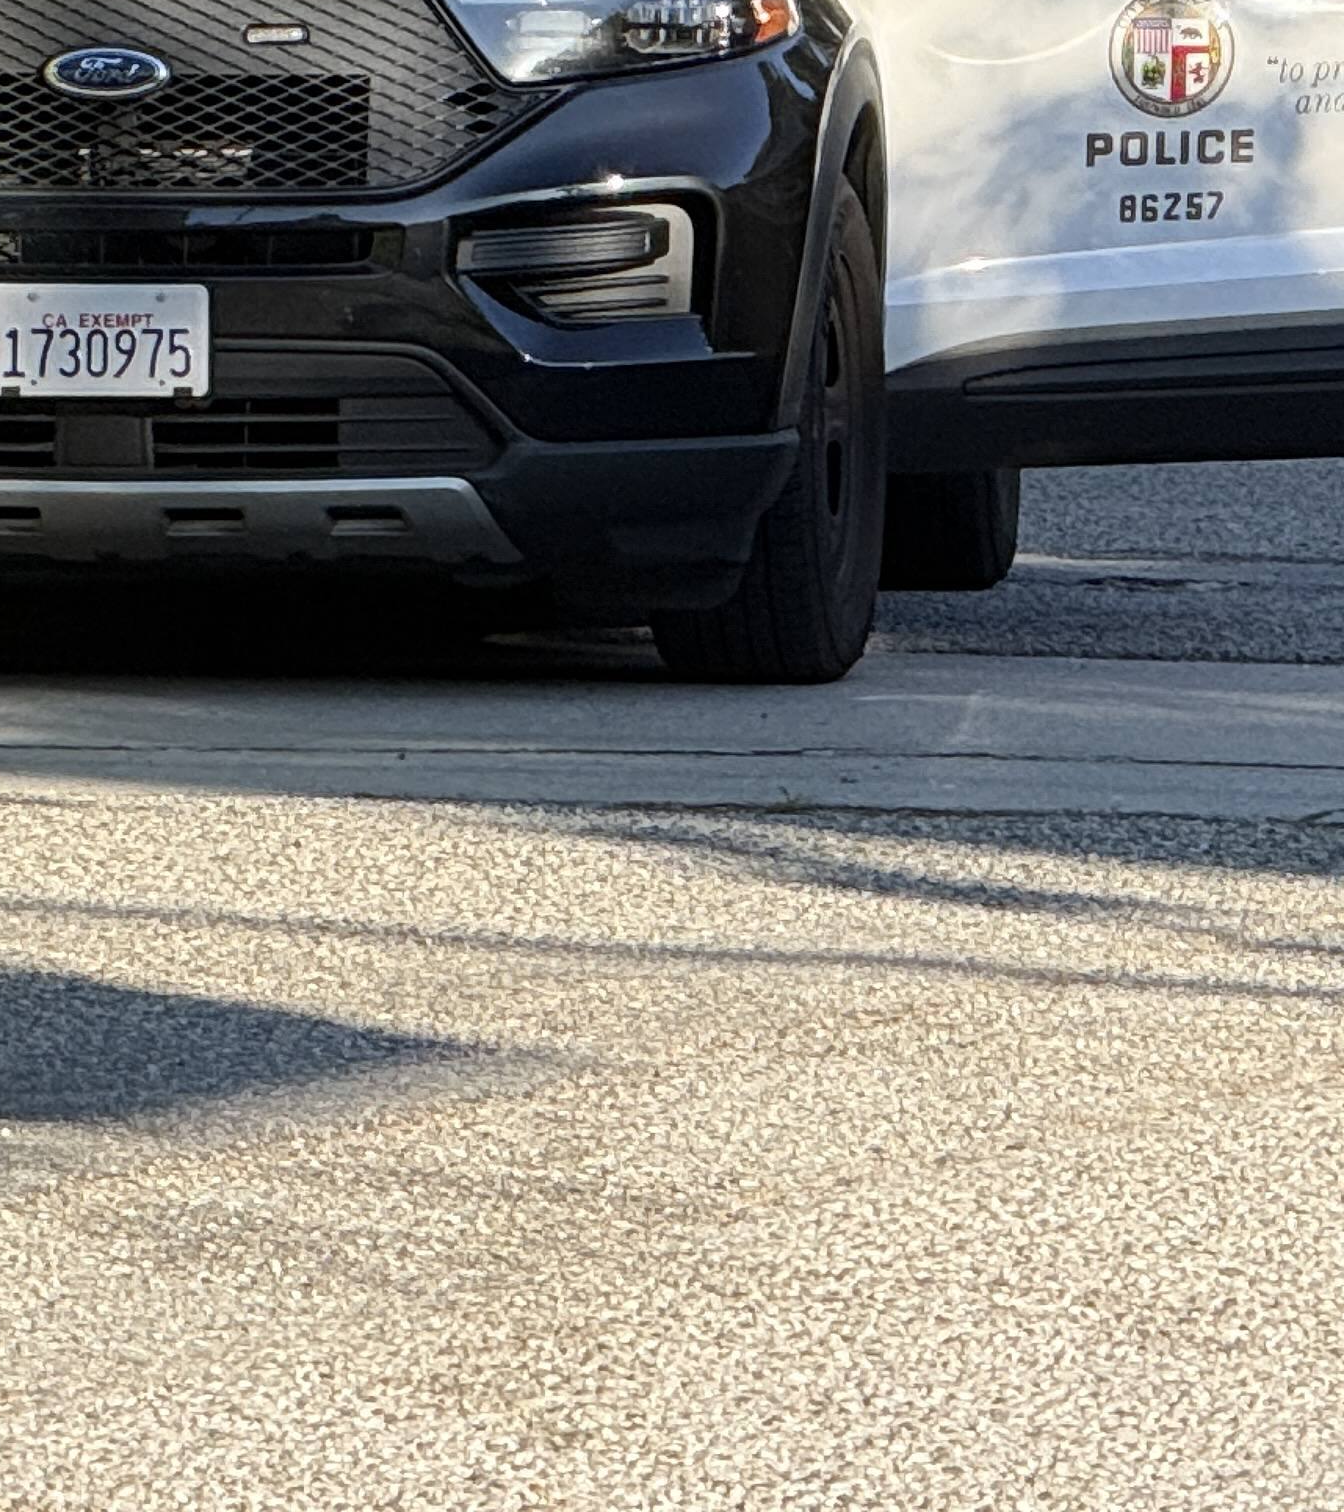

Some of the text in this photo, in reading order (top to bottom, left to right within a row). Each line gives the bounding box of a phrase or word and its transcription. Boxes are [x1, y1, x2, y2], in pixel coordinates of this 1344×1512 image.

[1085, 129, 1254, 167] POLICE
[1119, 191, 1224, 223] 86257
[42, 312, 154, 329] CA EXEMPT
[2, 326, 192, 379] 1730975
